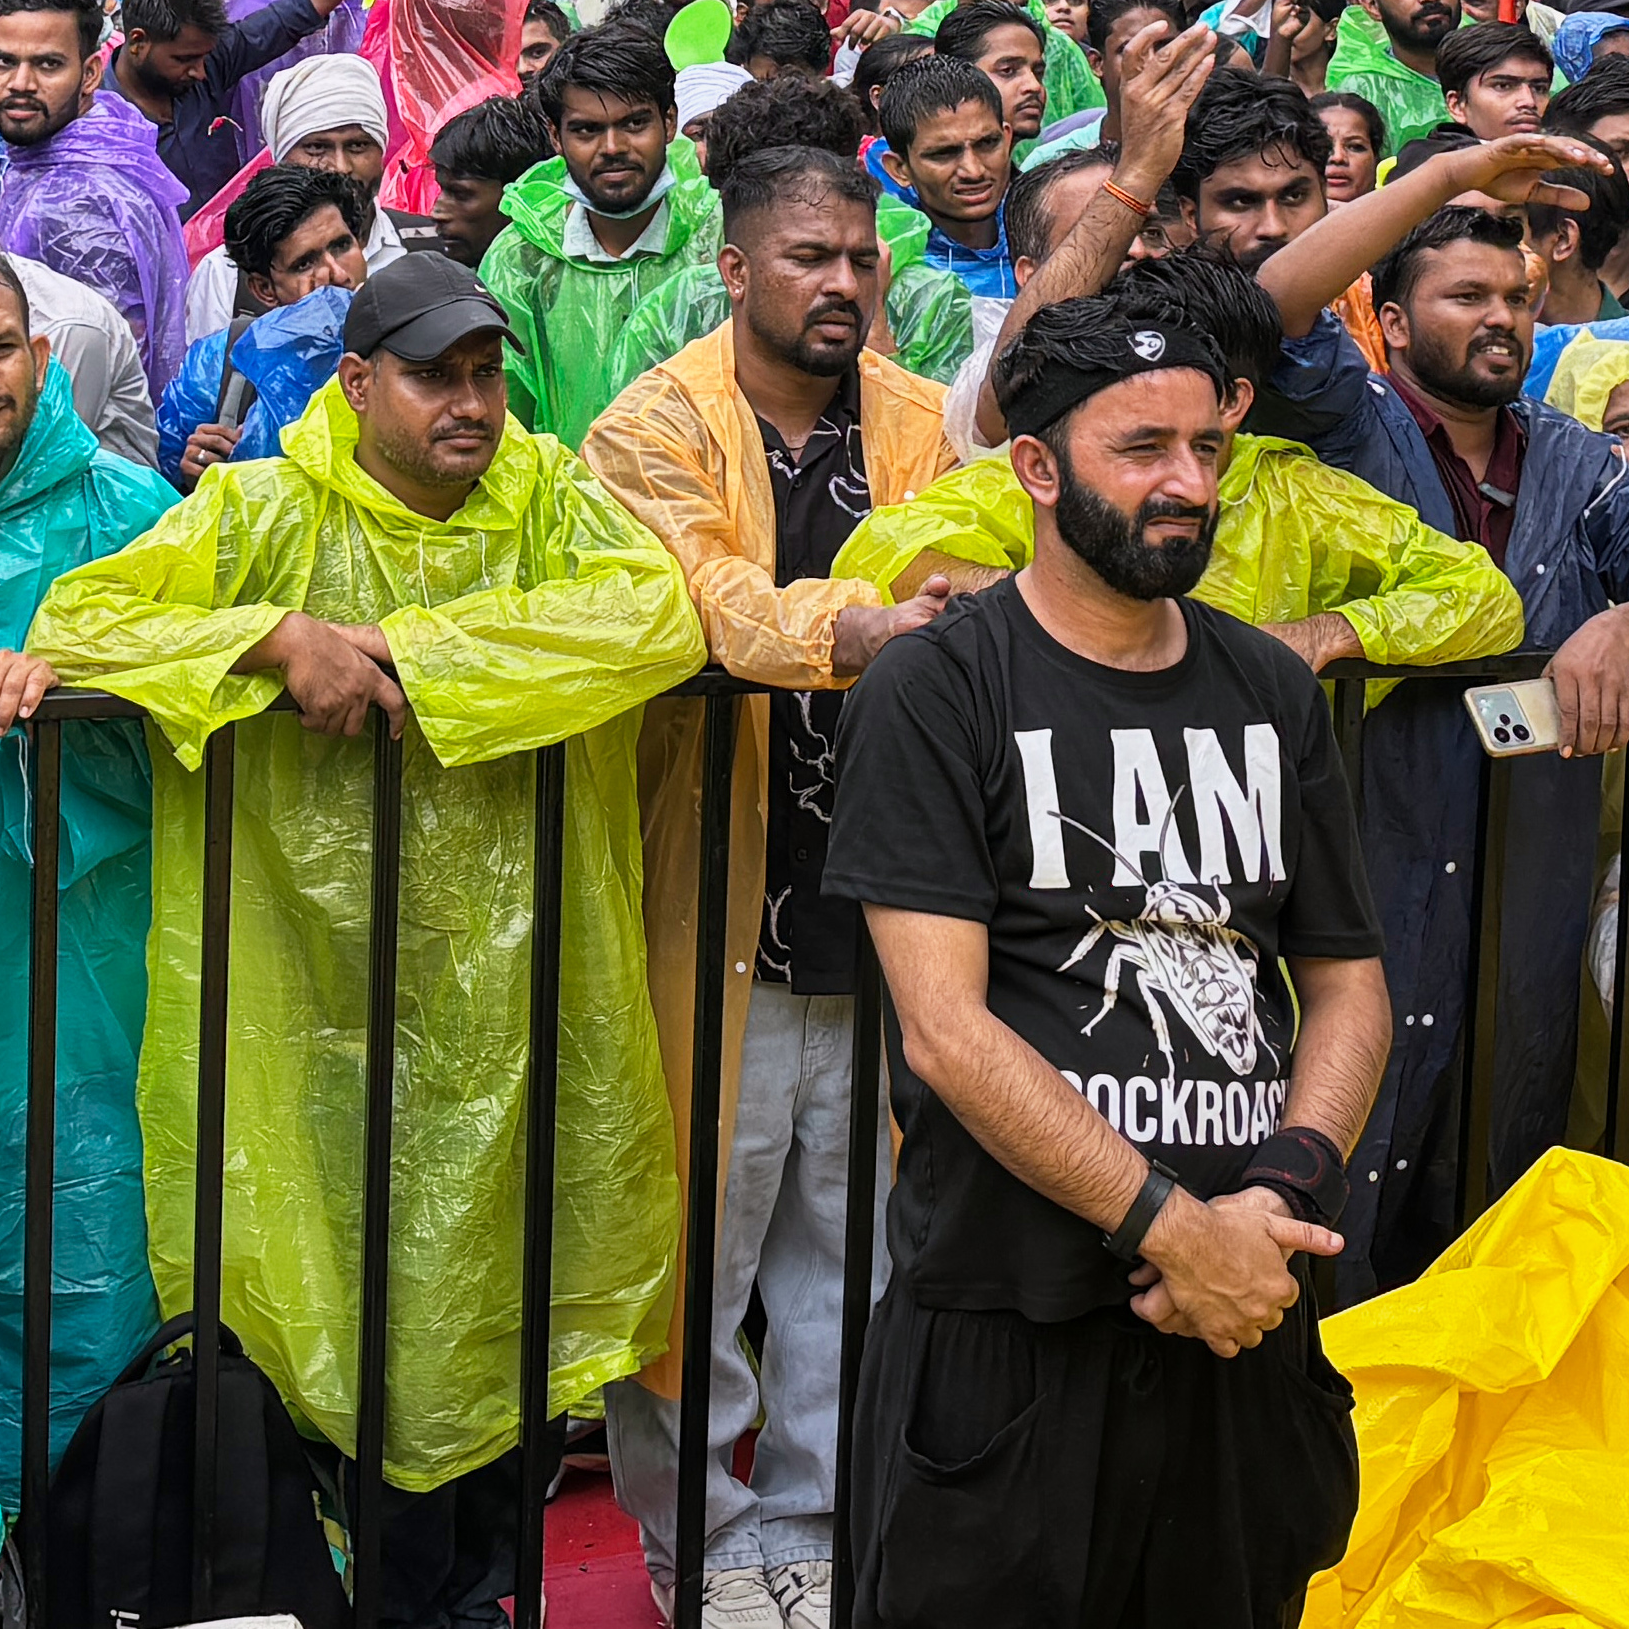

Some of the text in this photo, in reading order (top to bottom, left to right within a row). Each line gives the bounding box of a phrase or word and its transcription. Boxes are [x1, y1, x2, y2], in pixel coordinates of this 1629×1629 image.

[1014, 723, 1287, 889] I AM
[1060, 1070, 1289, 1146] OCKROAC
